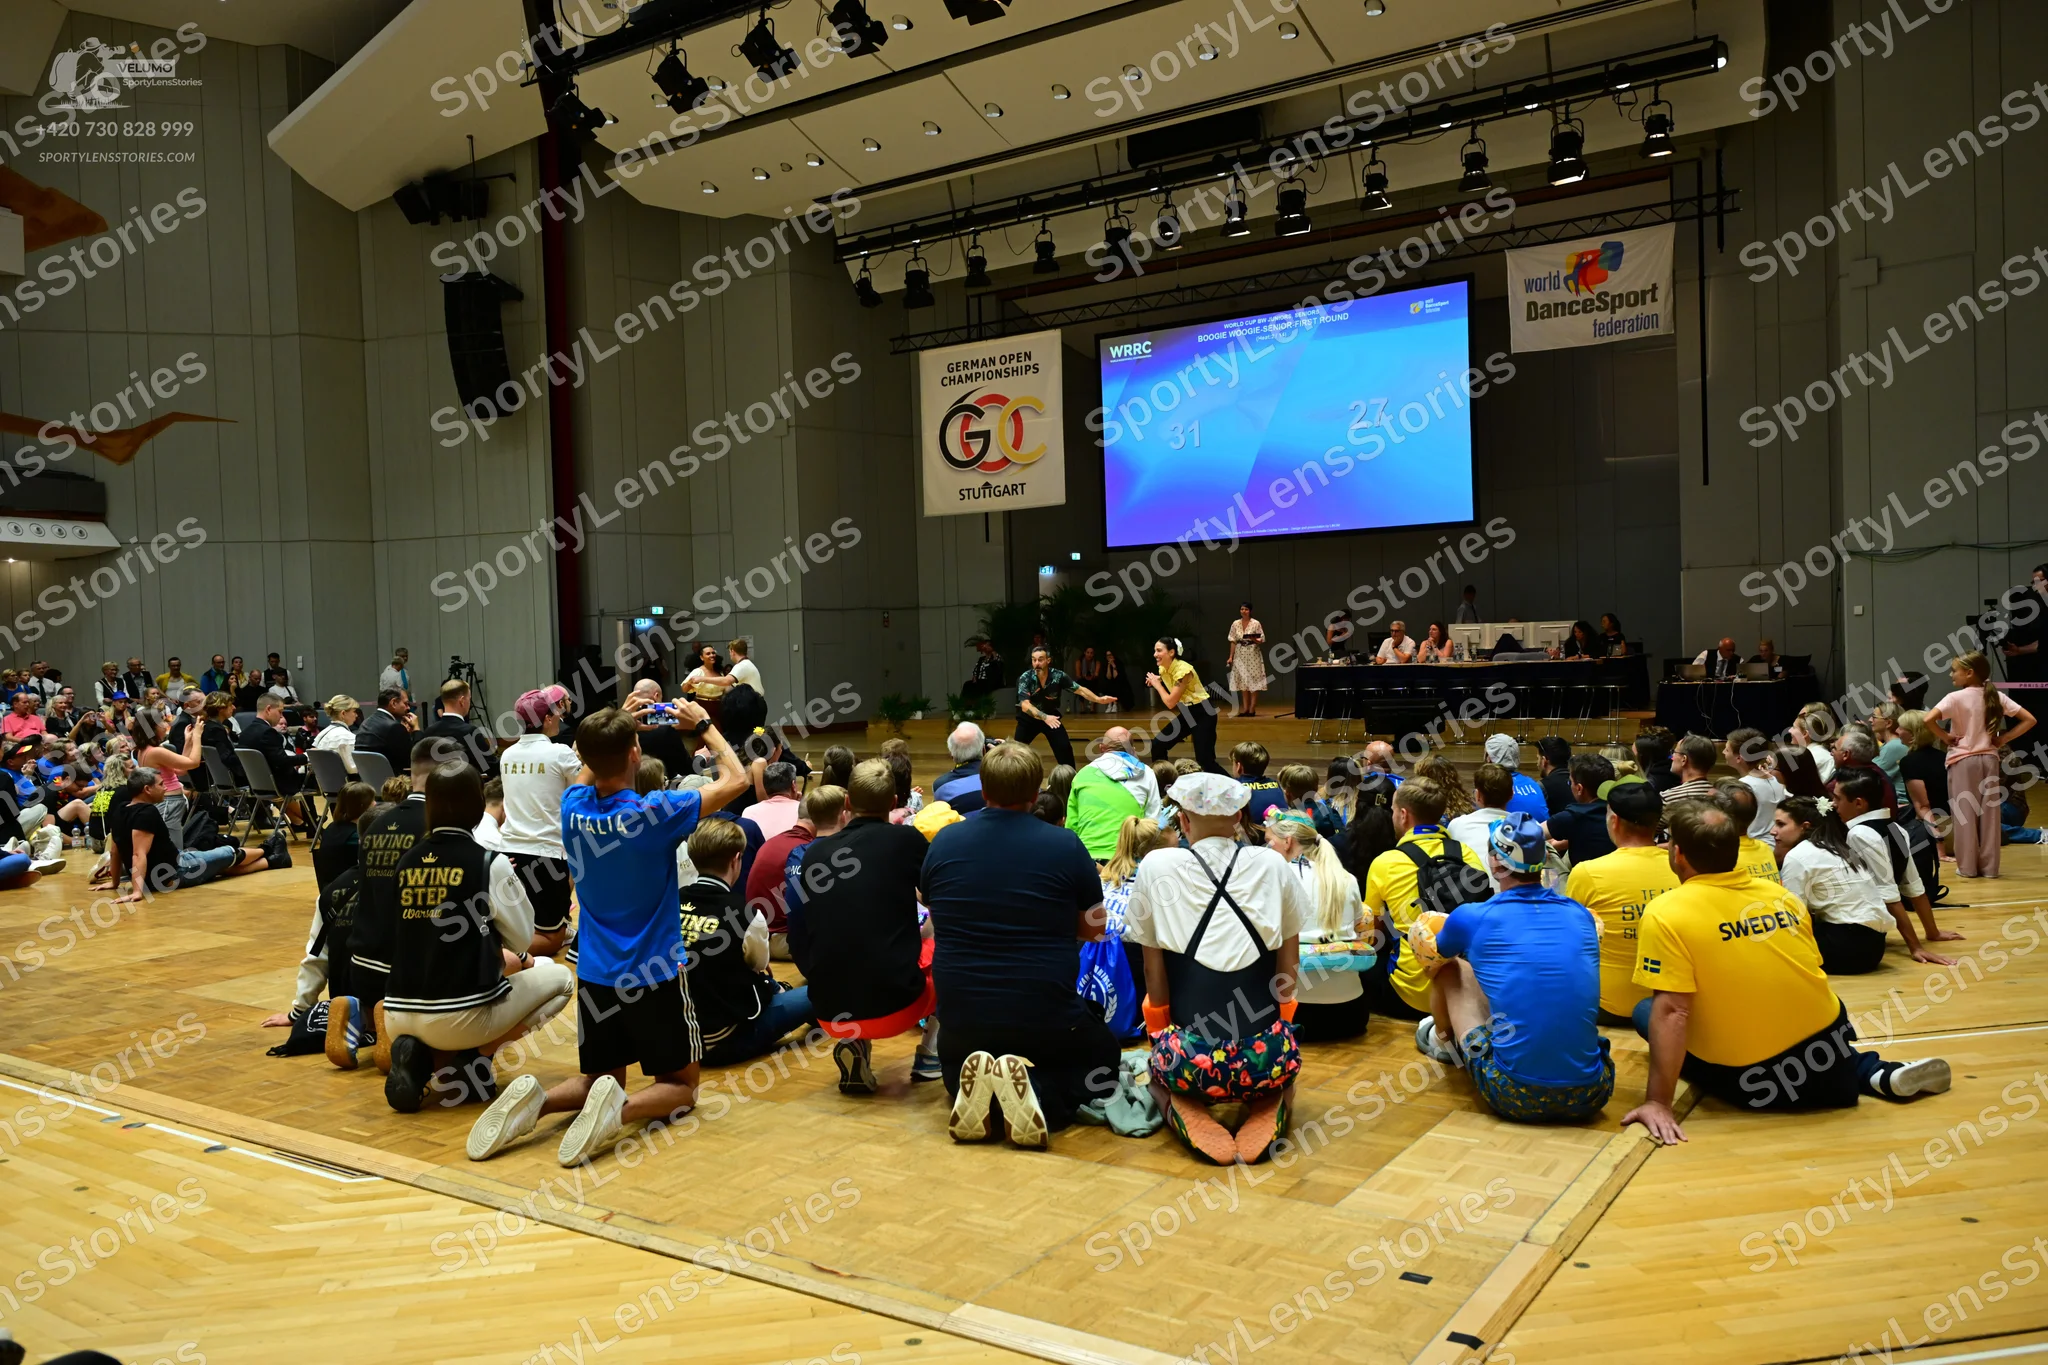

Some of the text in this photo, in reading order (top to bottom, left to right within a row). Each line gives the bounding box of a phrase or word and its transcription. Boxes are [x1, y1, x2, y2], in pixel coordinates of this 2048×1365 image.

[1524, 270, 1561, 294] world
[1526, 283, 1659, 322] DanceSport
[1198, 332, 1227, 343] BOOGIE
[1319, 312, 1349, 324] ROUND
[1592, 312, 1659, 338] federation
[1110, 341, 1152, 358] WRRC
[946, 351, 1032, 374] GERMAN OPEN
[940, 363, 1040, 387] CHAMPIONSHIPS
[1348, 397, 1389, 430] 27
[1168, 420, 1200, 450] 31
[958, 482, 1027, 501] STUTTGART
[570, 812, 628, 835] ITALIA
[362, 834, 415, 850] SWING
[366, 851, 400, 866] STEP
[1747, 861, 1774, 874] TEAM
[400, 886, 448, 907] STEP
[402, 908, 443, 920] Warsaw
[680, 913, 719, 934] ING
[1719, 910, 1800, 941] SWEDEN
